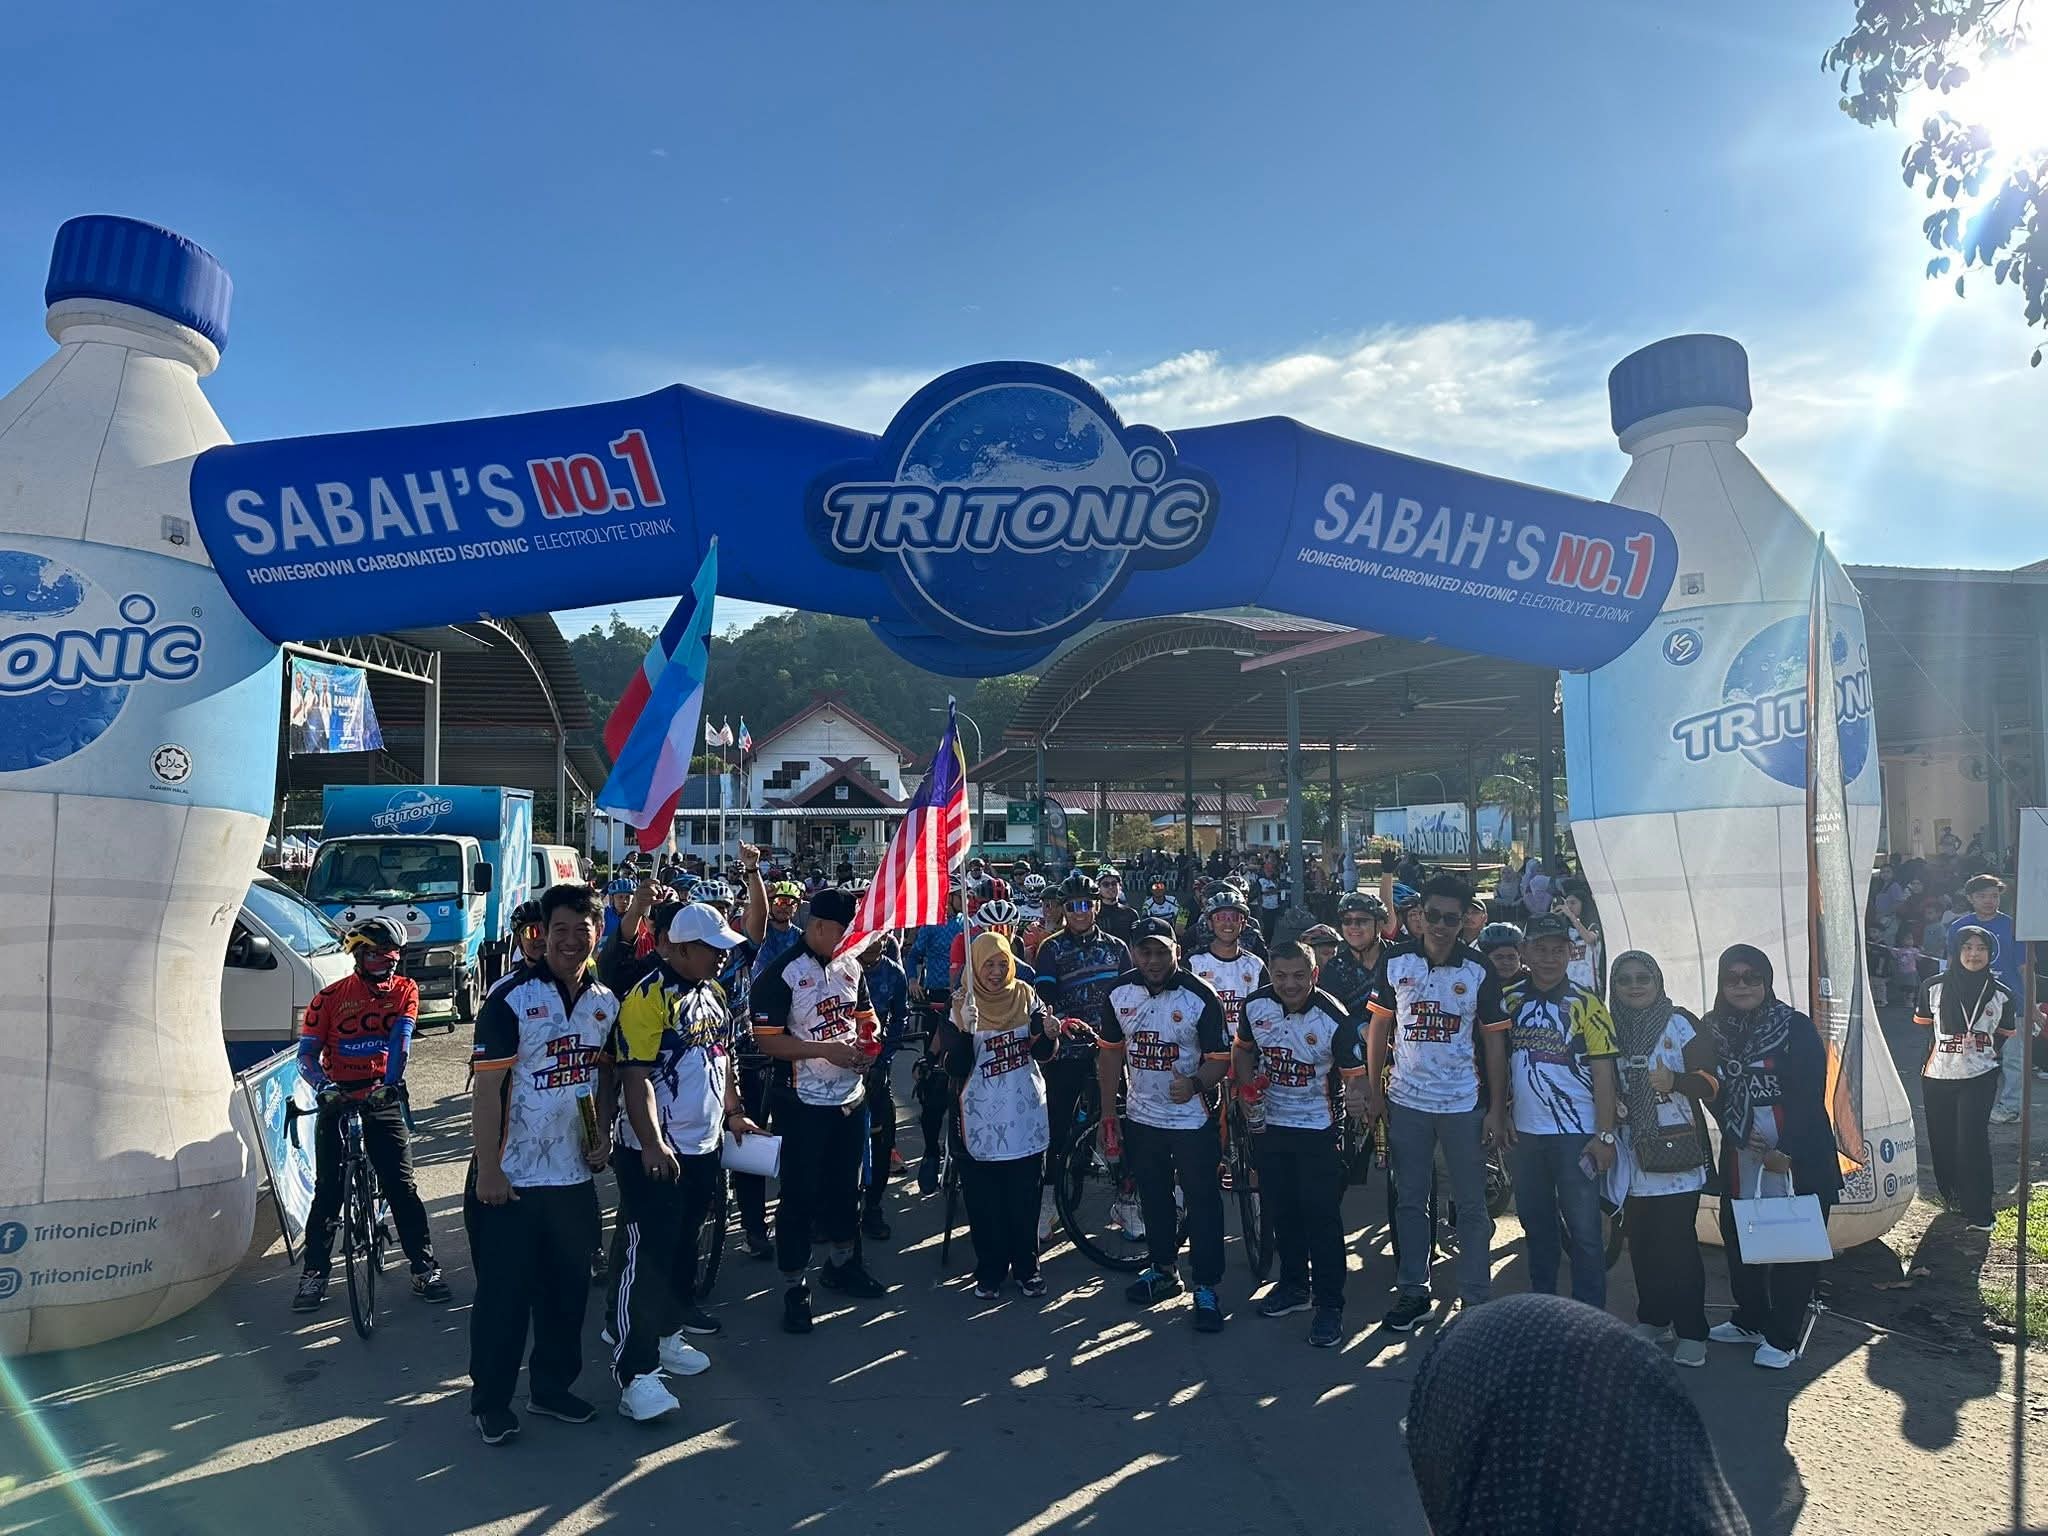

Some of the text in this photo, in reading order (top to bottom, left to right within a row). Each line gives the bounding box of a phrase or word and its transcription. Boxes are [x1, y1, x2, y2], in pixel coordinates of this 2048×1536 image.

[226, 429, 666, 555] SABAH'S NO.1
[824, 447, 1209, 553] TRITONIC
[247, 518, 675, 585] HOMEGROWN CARBONATED ISOTONIC ELECTROLYTE DRINK
[1313, 483, 1655, 599] SABAH'S NO.1
[1297, 548, 1633, 622] HOMEGROWN CARBONATED ISOTONIC ELECTROLYTE DRINK
[372, 796, 452, 829] TRITONIC
[1265, 1071, 1307, 1086] GARA
[34, 1216, 159, 1242] TritonicDrink
[29, 1258, 152, 1287] TritonicDrink
